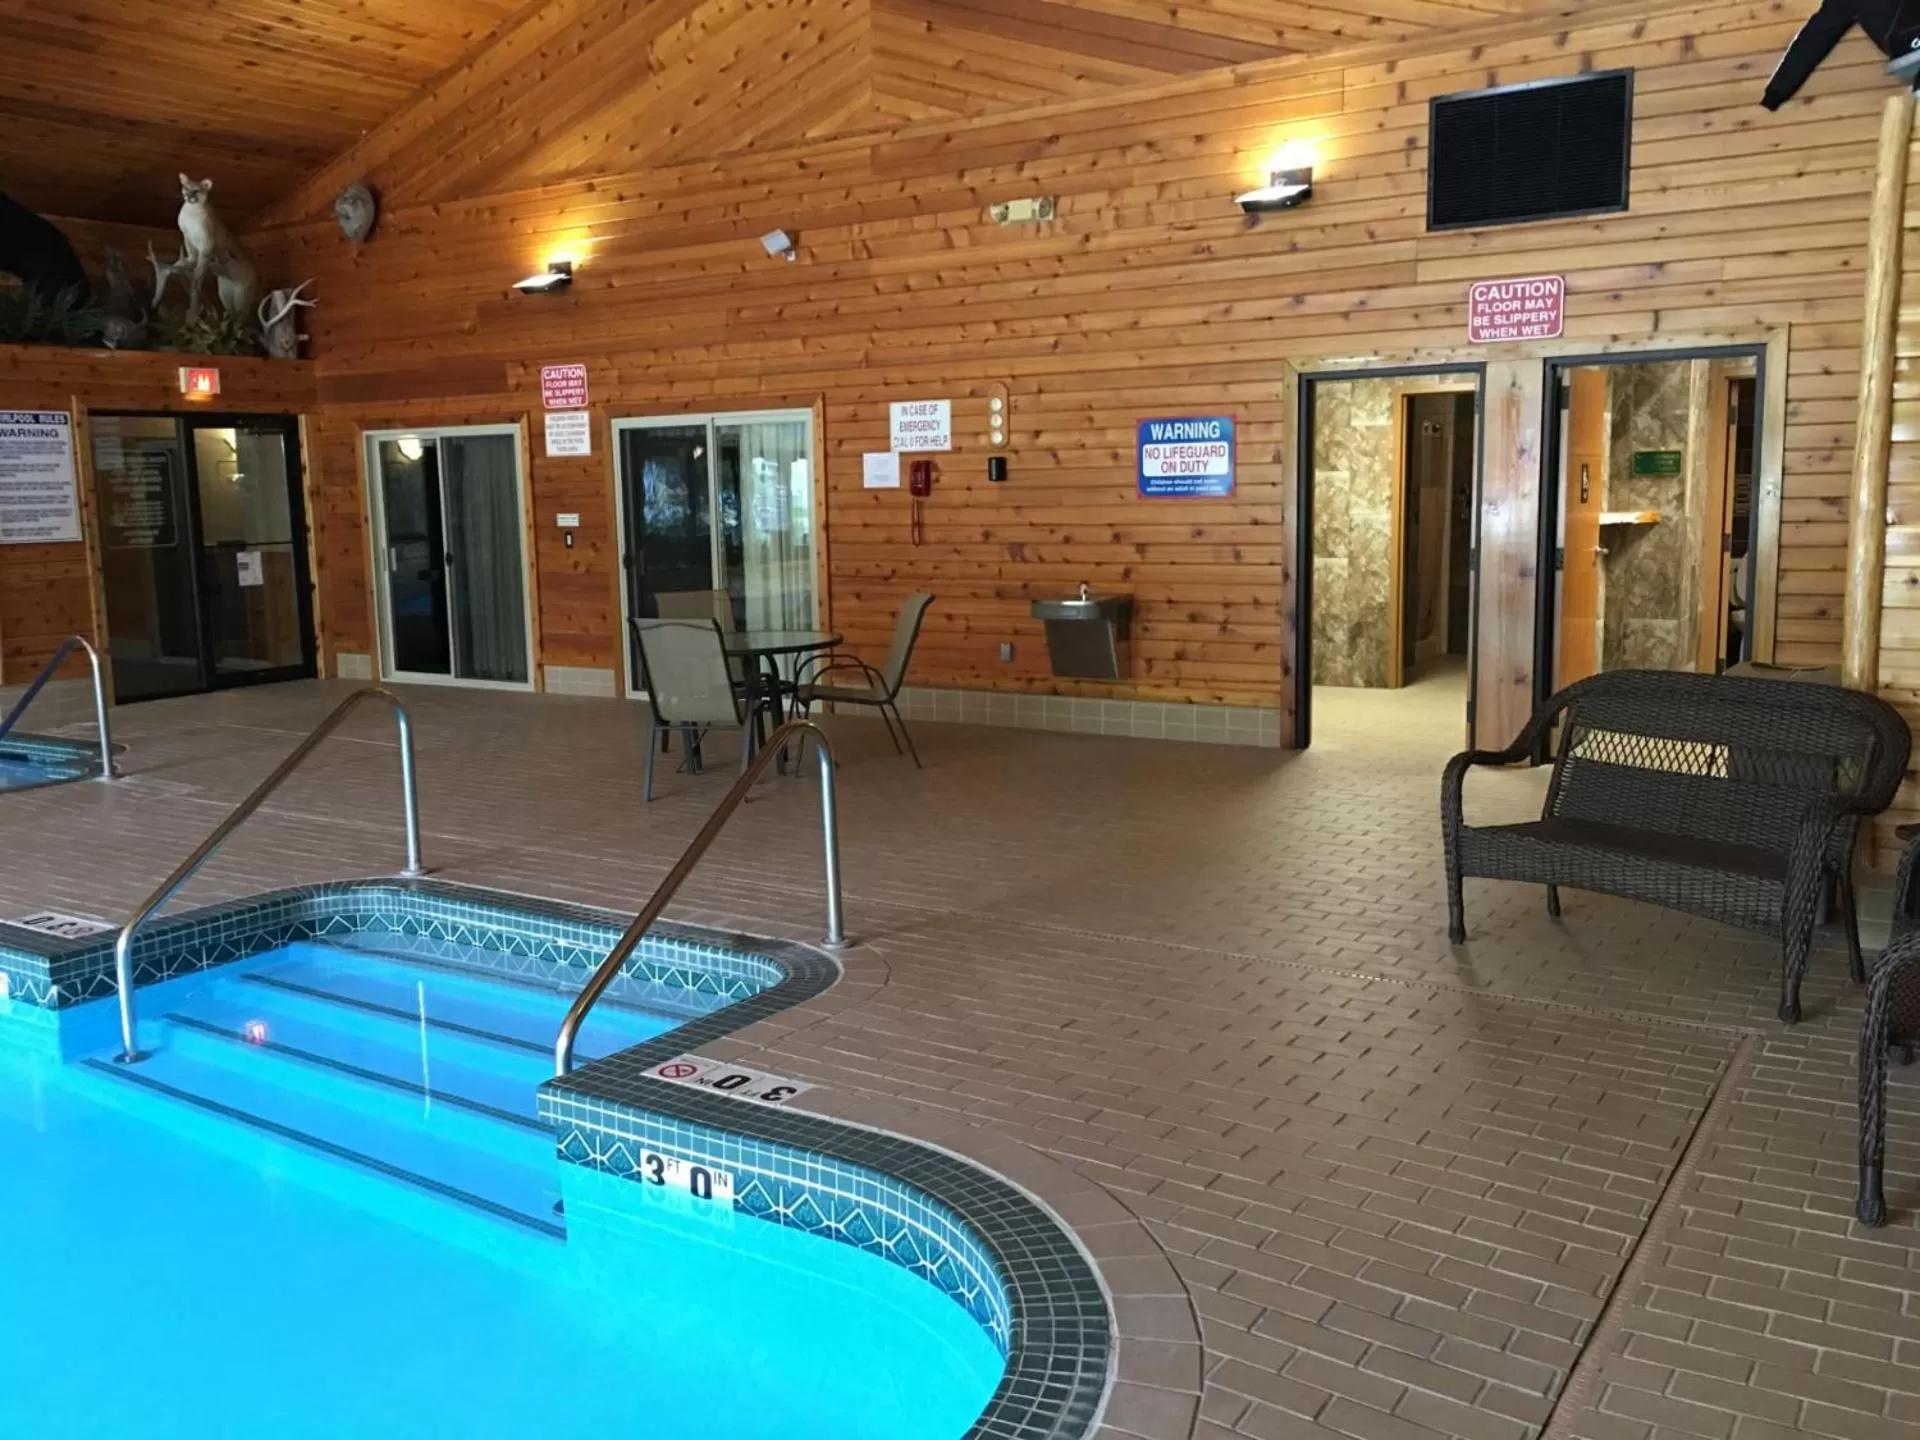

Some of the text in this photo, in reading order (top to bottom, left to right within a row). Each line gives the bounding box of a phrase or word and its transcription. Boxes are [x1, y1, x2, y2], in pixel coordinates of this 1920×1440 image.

[1474, 281, 1558, 301] CAUTION
[1477, 298, 1554, 313] FLOOR MAY
[1473, 310, 1557, 327] BE SLIPPERY
[1479, 324, 1550, 339] WHEN WET
[543, 368, 584, 379] CAUTION
[901, 403, 938, 416] IN CASE OF
[899, 420, 940, 432] EMERGENCY
[1150, 421, 1220, 440] WARNING
[915, 435, 929, 447] FOR
[930, 434, 948, 447] HELP
[1144, 444, 1227, 460] NO LIFEGUARD
[1160, 460, 1209, 473] ON DUTY
[712, 1074, 752, 1090] 0
[760, 1086, 798, 1101] 3
[645, 1153, 728, 1200] 3 FT 0 IN
